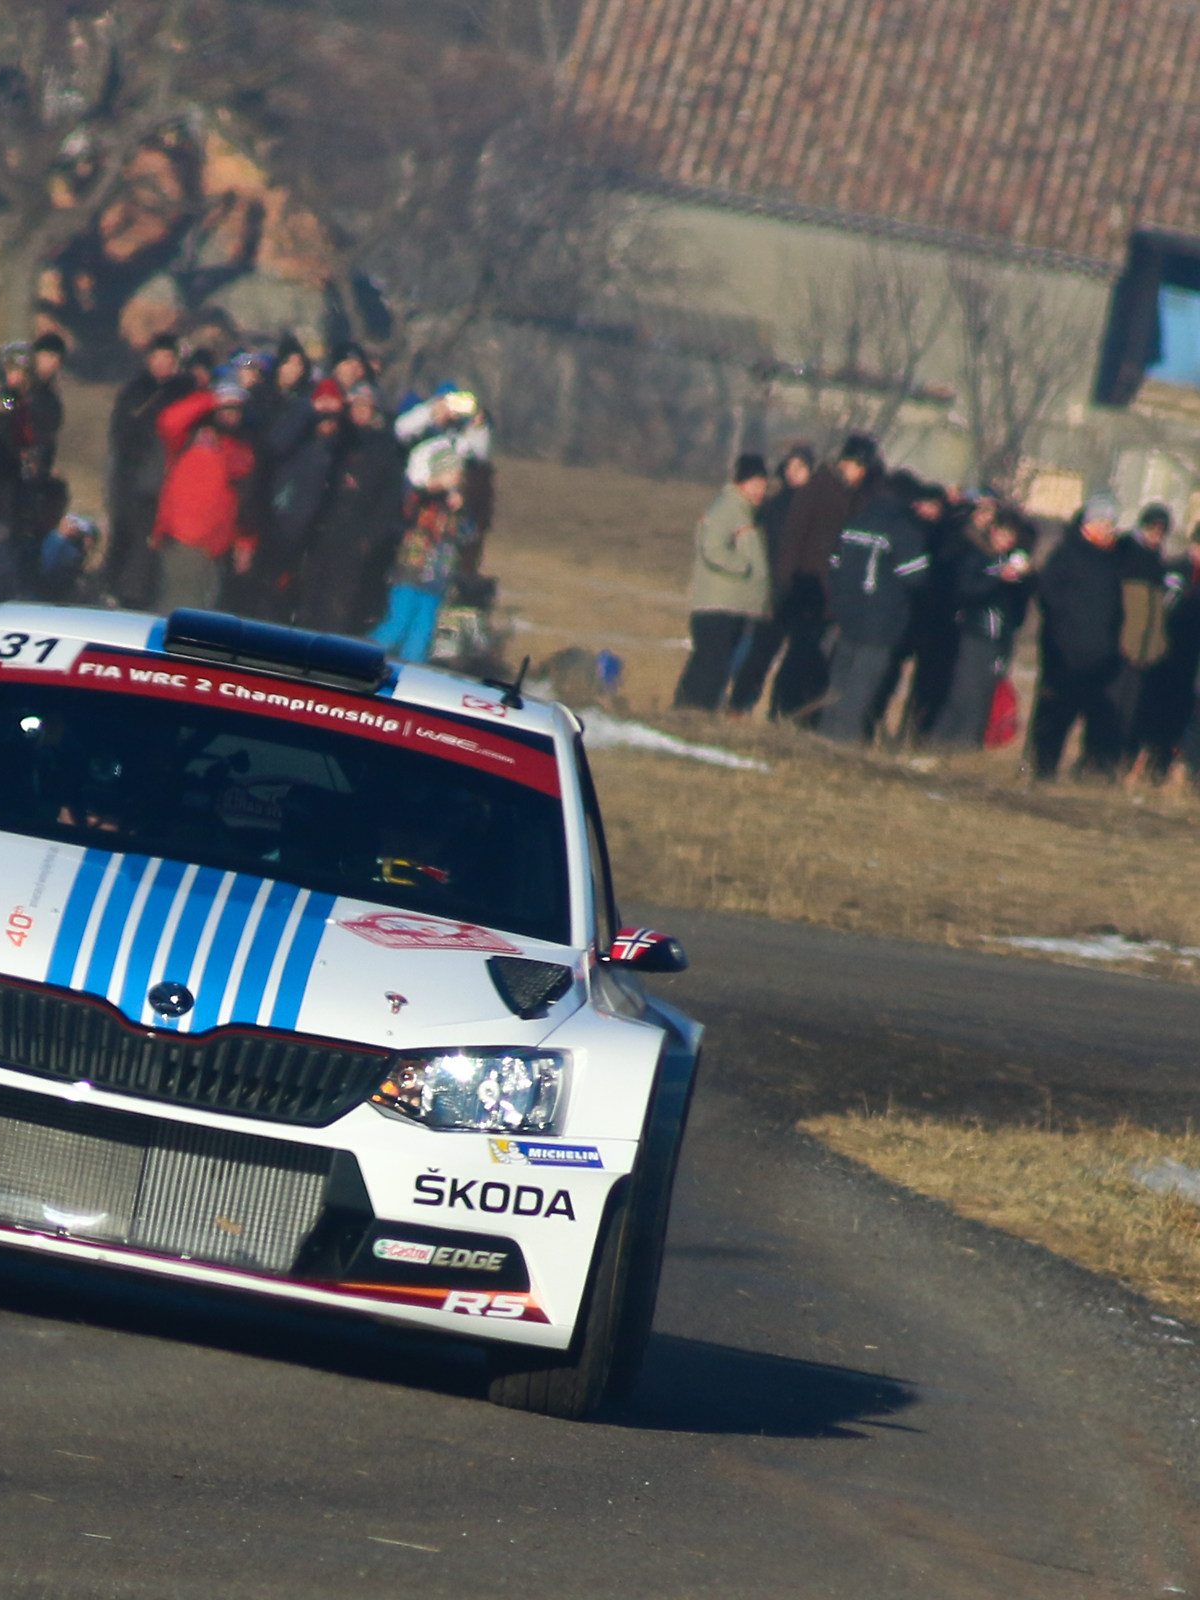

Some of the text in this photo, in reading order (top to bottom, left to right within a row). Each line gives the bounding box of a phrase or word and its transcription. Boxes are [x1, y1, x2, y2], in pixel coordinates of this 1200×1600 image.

[78, 662, 400, 733] FIA WRC 2 Championship
[528, 1148, 600, 1161] MICHELIN
[412, 1167, 576, 1222] ŠKODA
[430, 1246, 509, 1272] EDGE
[441, 1290, 529, 1318] RS
